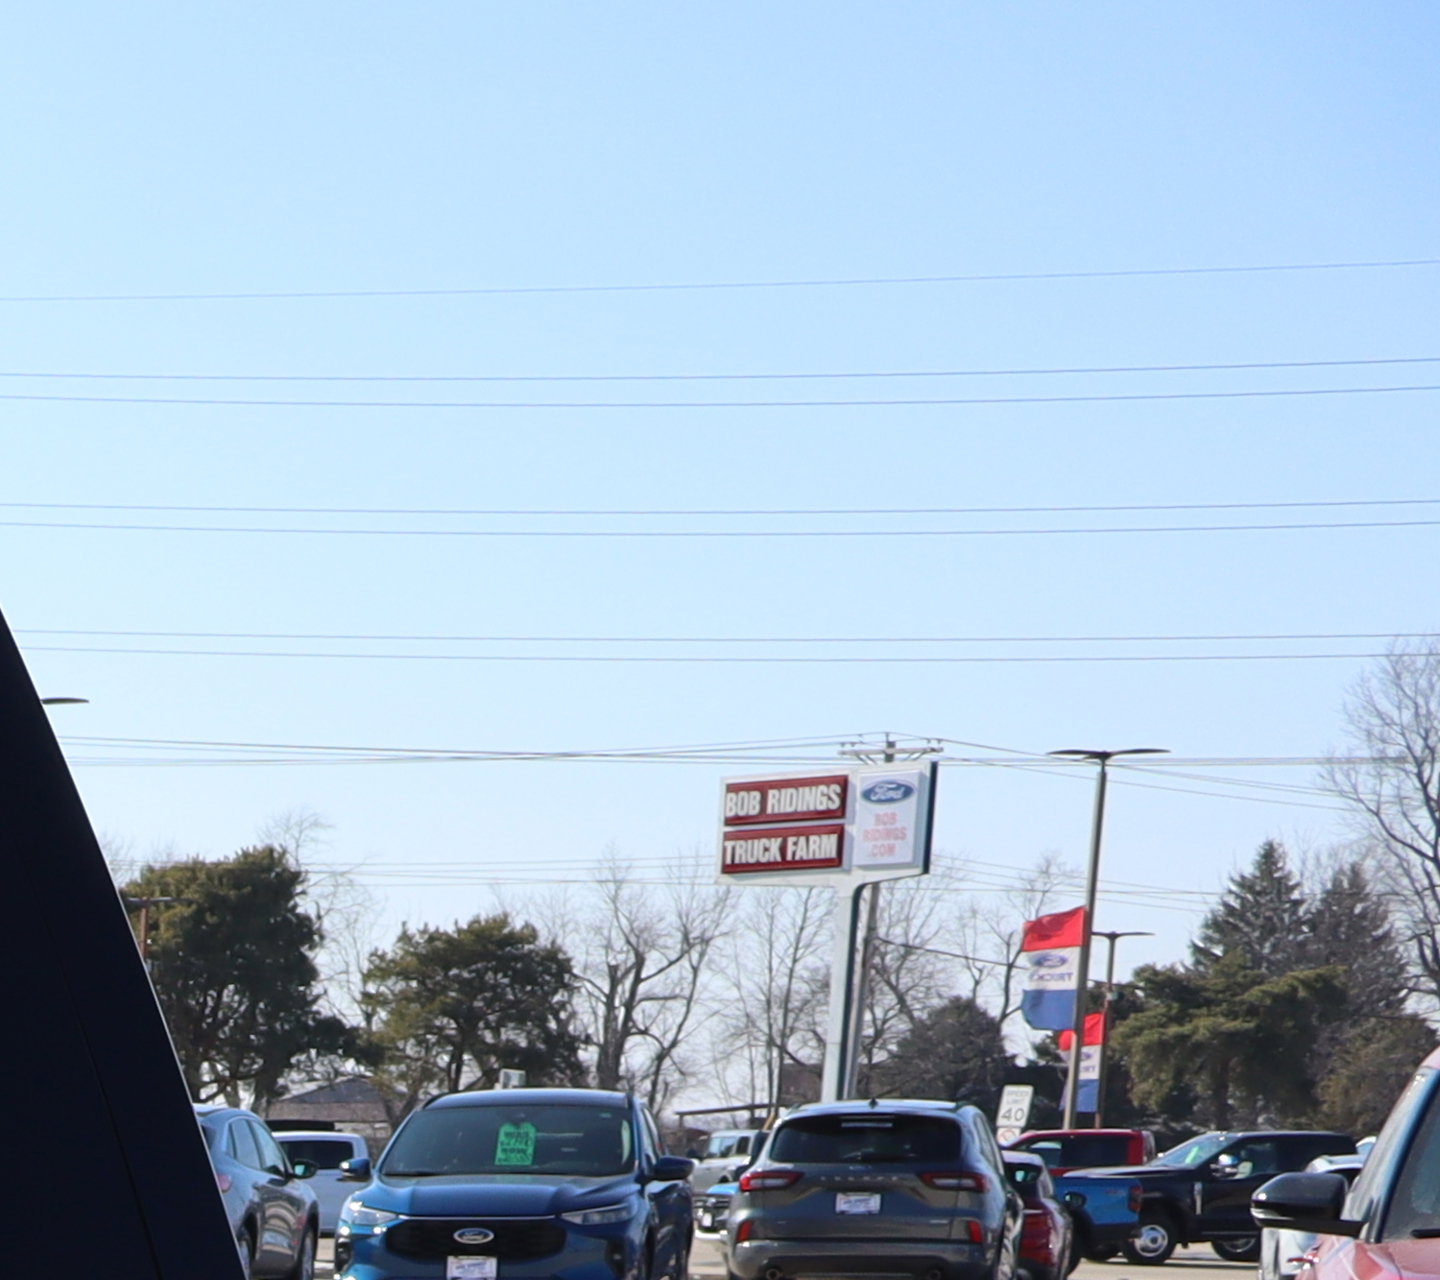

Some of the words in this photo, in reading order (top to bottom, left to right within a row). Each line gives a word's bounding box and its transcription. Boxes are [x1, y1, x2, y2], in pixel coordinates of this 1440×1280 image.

[725, 791, 761, 818] BOB
[766, 784, 842, 814] RIDINGS
[724, 838, 782, 864] TRUCK
[786, 833, 838, 861] FARM
[1001, 1107, 1025, 1122] 40
